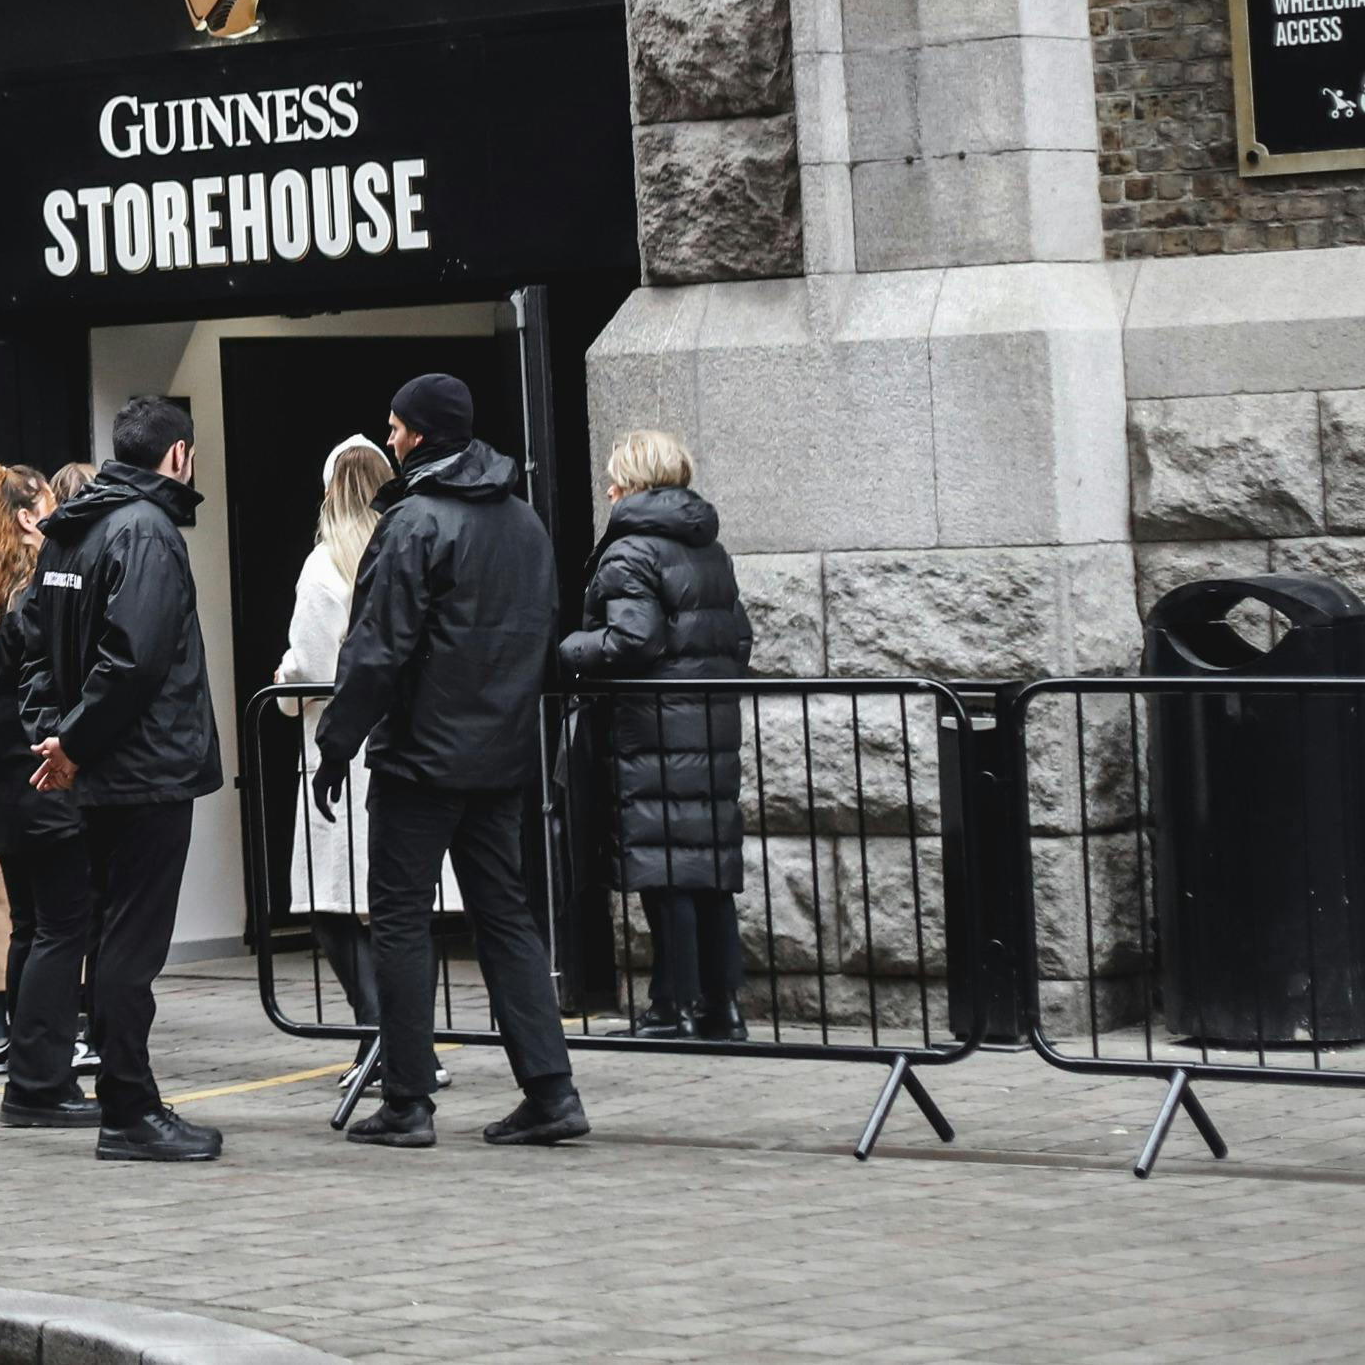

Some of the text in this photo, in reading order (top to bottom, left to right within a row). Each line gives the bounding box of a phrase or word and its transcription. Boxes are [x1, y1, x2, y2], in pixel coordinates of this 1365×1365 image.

[1276, 16, 1342, 46] ACCESS
[100, 82, 359, 158] GUINNESS
[43, 158, 430, 277] STOREHOUSE
